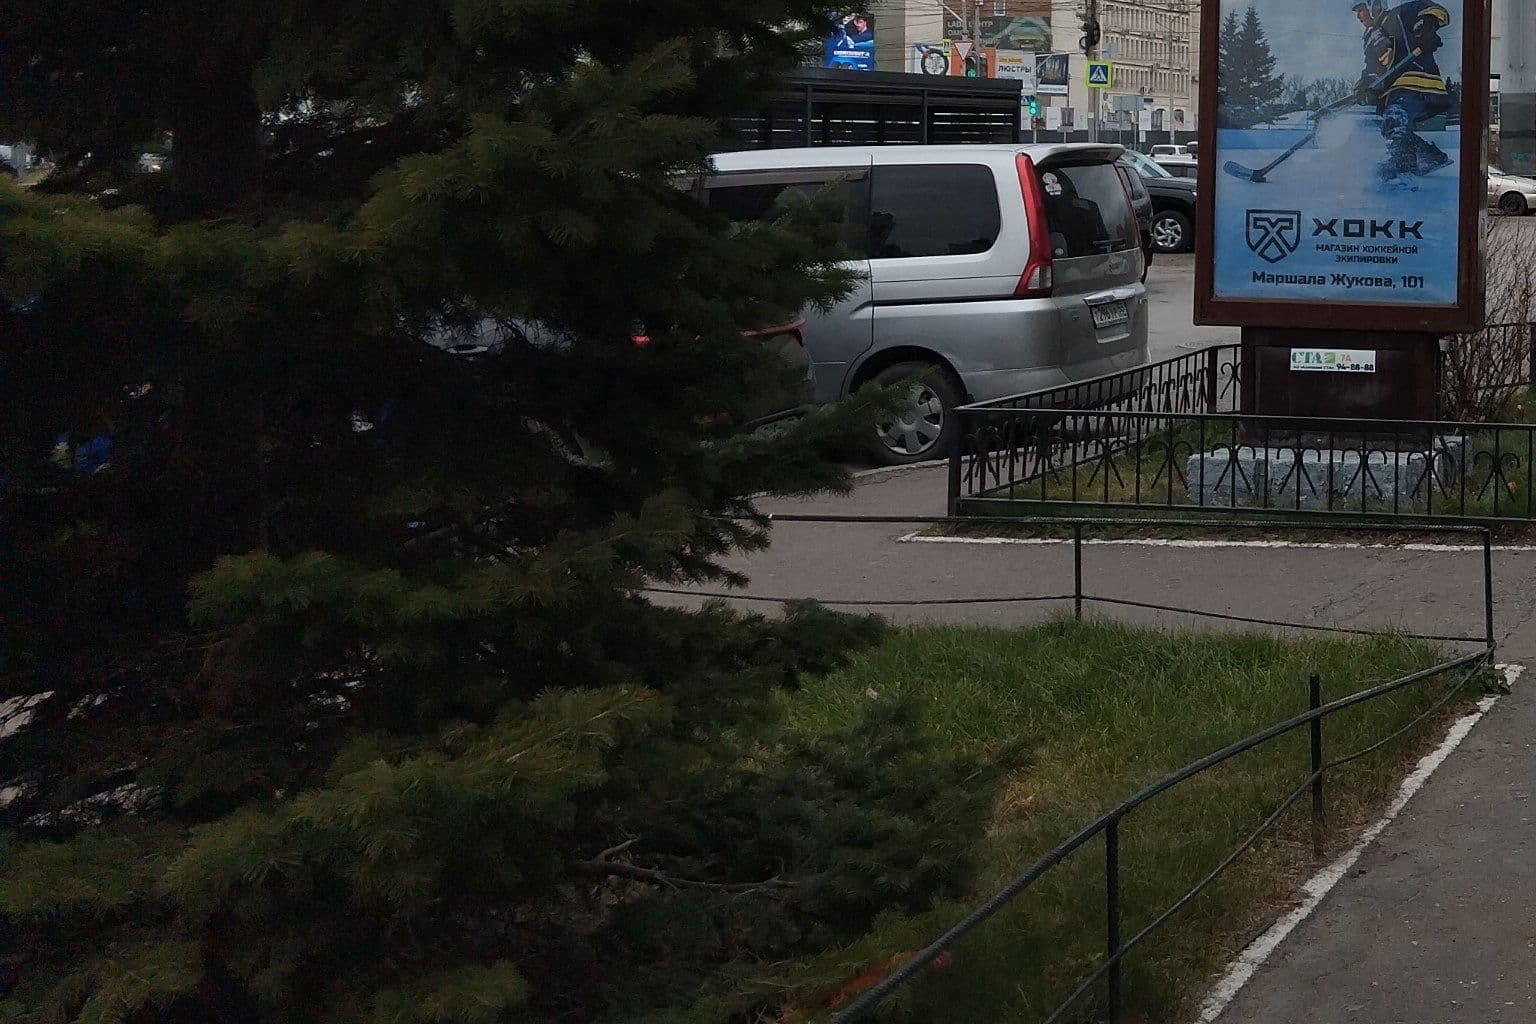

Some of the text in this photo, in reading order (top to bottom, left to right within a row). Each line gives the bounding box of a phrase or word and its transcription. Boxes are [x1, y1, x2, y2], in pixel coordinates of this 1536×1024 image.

[998, 65, 1032, 73] ЛЮСТРЫ
[1312, 218, 1424, 240] ХОКК
[1315, 243, 1418, 255] МАГАЗИН ХОККЕЙНОЙ
[1335, 254, 1399, 265] ЭКИПИРОВКИ
[1252, 270, 1424, 289] Маршала Жукова, 101
[1291, 351, 1323, 364] СТА
